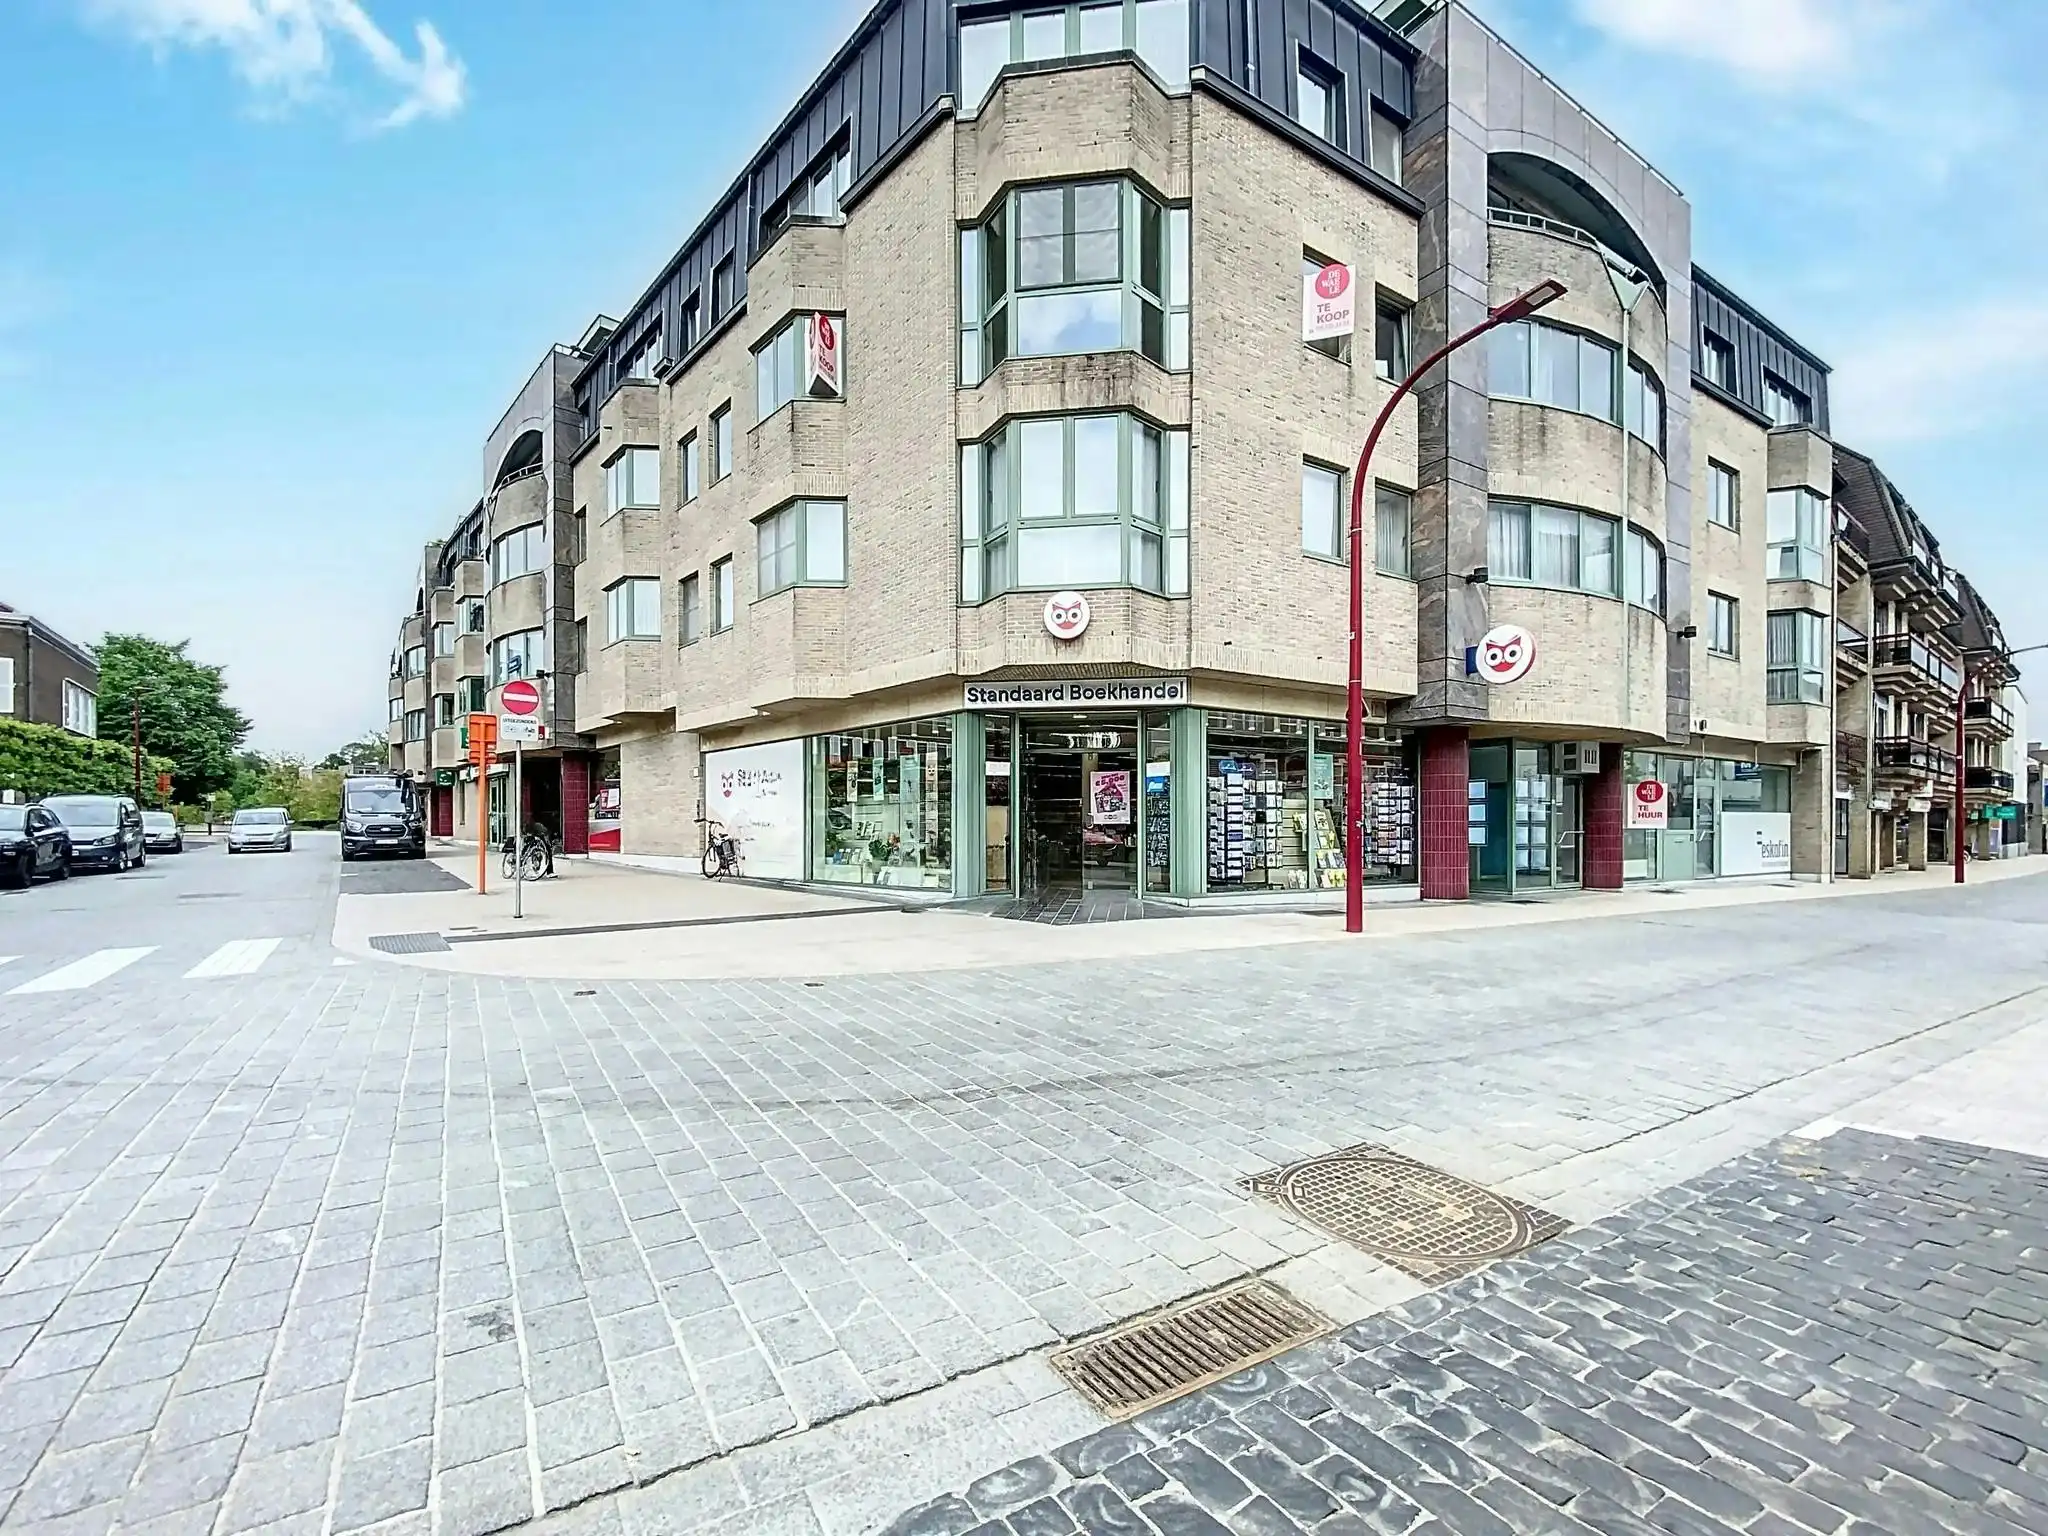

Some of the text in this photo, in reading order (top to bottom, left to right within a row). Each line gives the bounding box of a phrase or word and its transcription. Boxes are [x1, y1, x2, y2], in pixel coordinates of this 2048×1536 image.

[1316, 302, 1331, 313] TE
[1316, 309, 1350, 324] KOOP
[967, 681, 1184, 703] Standaard Boekhandel
[1637, 804, 1649, 812] TE
